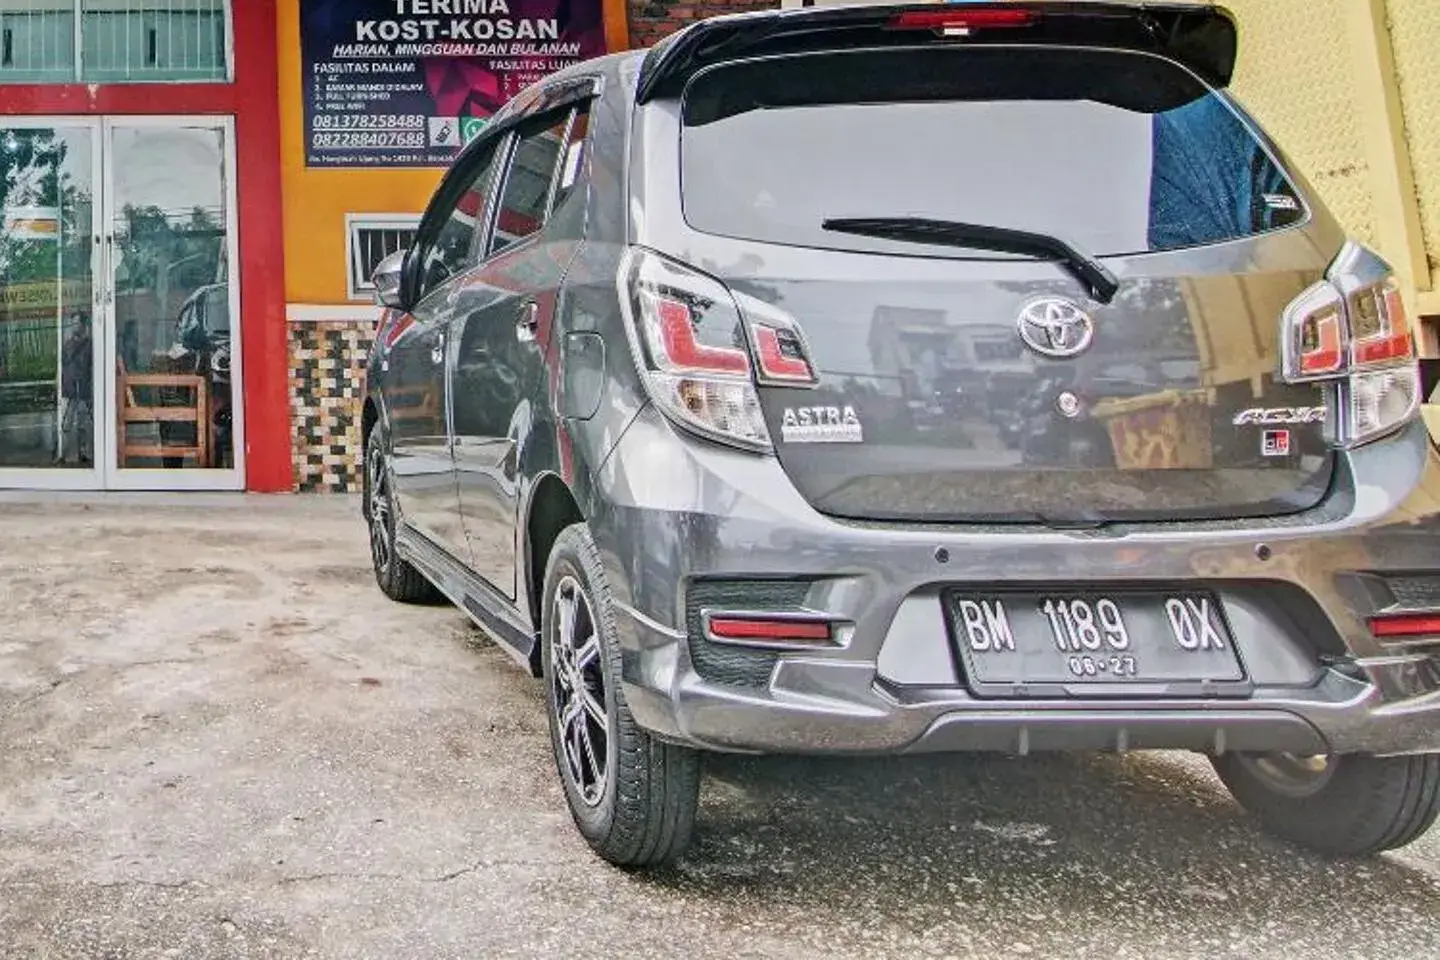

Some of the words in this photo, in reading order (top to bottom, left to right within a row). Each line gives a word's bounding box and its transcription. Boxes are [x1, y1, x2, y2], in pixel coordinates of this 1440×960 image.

[356, 19, 558, 40] KOST-KOSAN
[332, 43, 390, 57] HARIAN,
[394, 43, 474, 56] MINGGUAN
[476, 43, 507, 55] DAN
[510, 42, 580, 55] BULANAN
[313, 63, 369, 73] FASILITAS
[372, 63, 416, 72] DALAM
[313, 115, 424, 131] 081378258488
[782, 406, 860, 426] ASTRA
[959, 599, 1015, 651] BM
[1042, 598, 1130, 651] 1189
